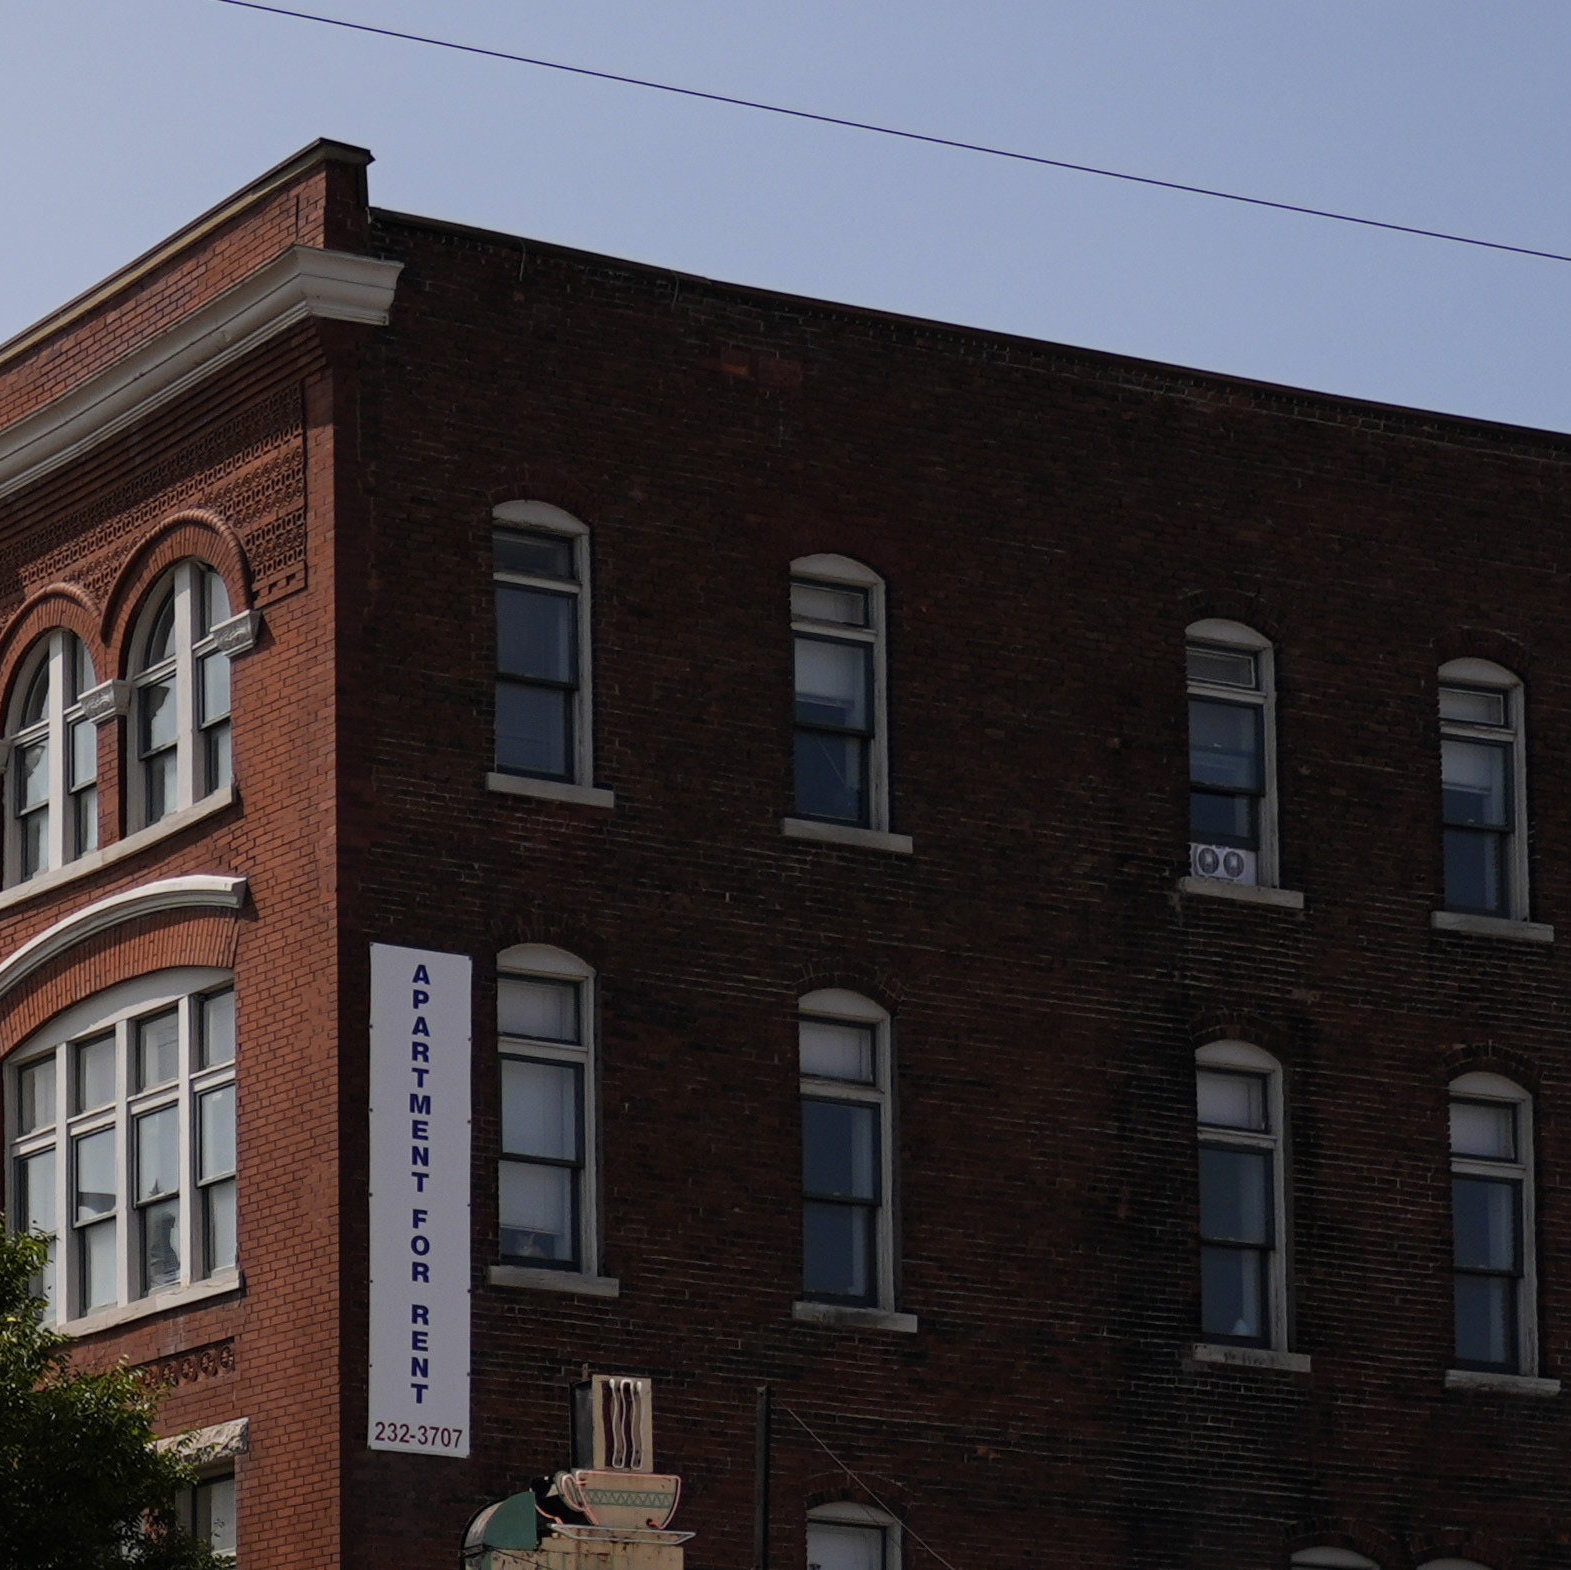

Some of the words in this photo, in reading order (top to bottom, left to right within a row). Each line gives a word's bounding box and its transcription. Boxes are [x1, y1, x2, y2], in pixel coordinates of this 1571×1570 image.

[408, 964, 432, 1193] APARTMENT
[410, 1208, 431, 1284] FOR
[410, 1304, 430, 1405] RENT
[373, 1420, 464, 1449] 232-3707
